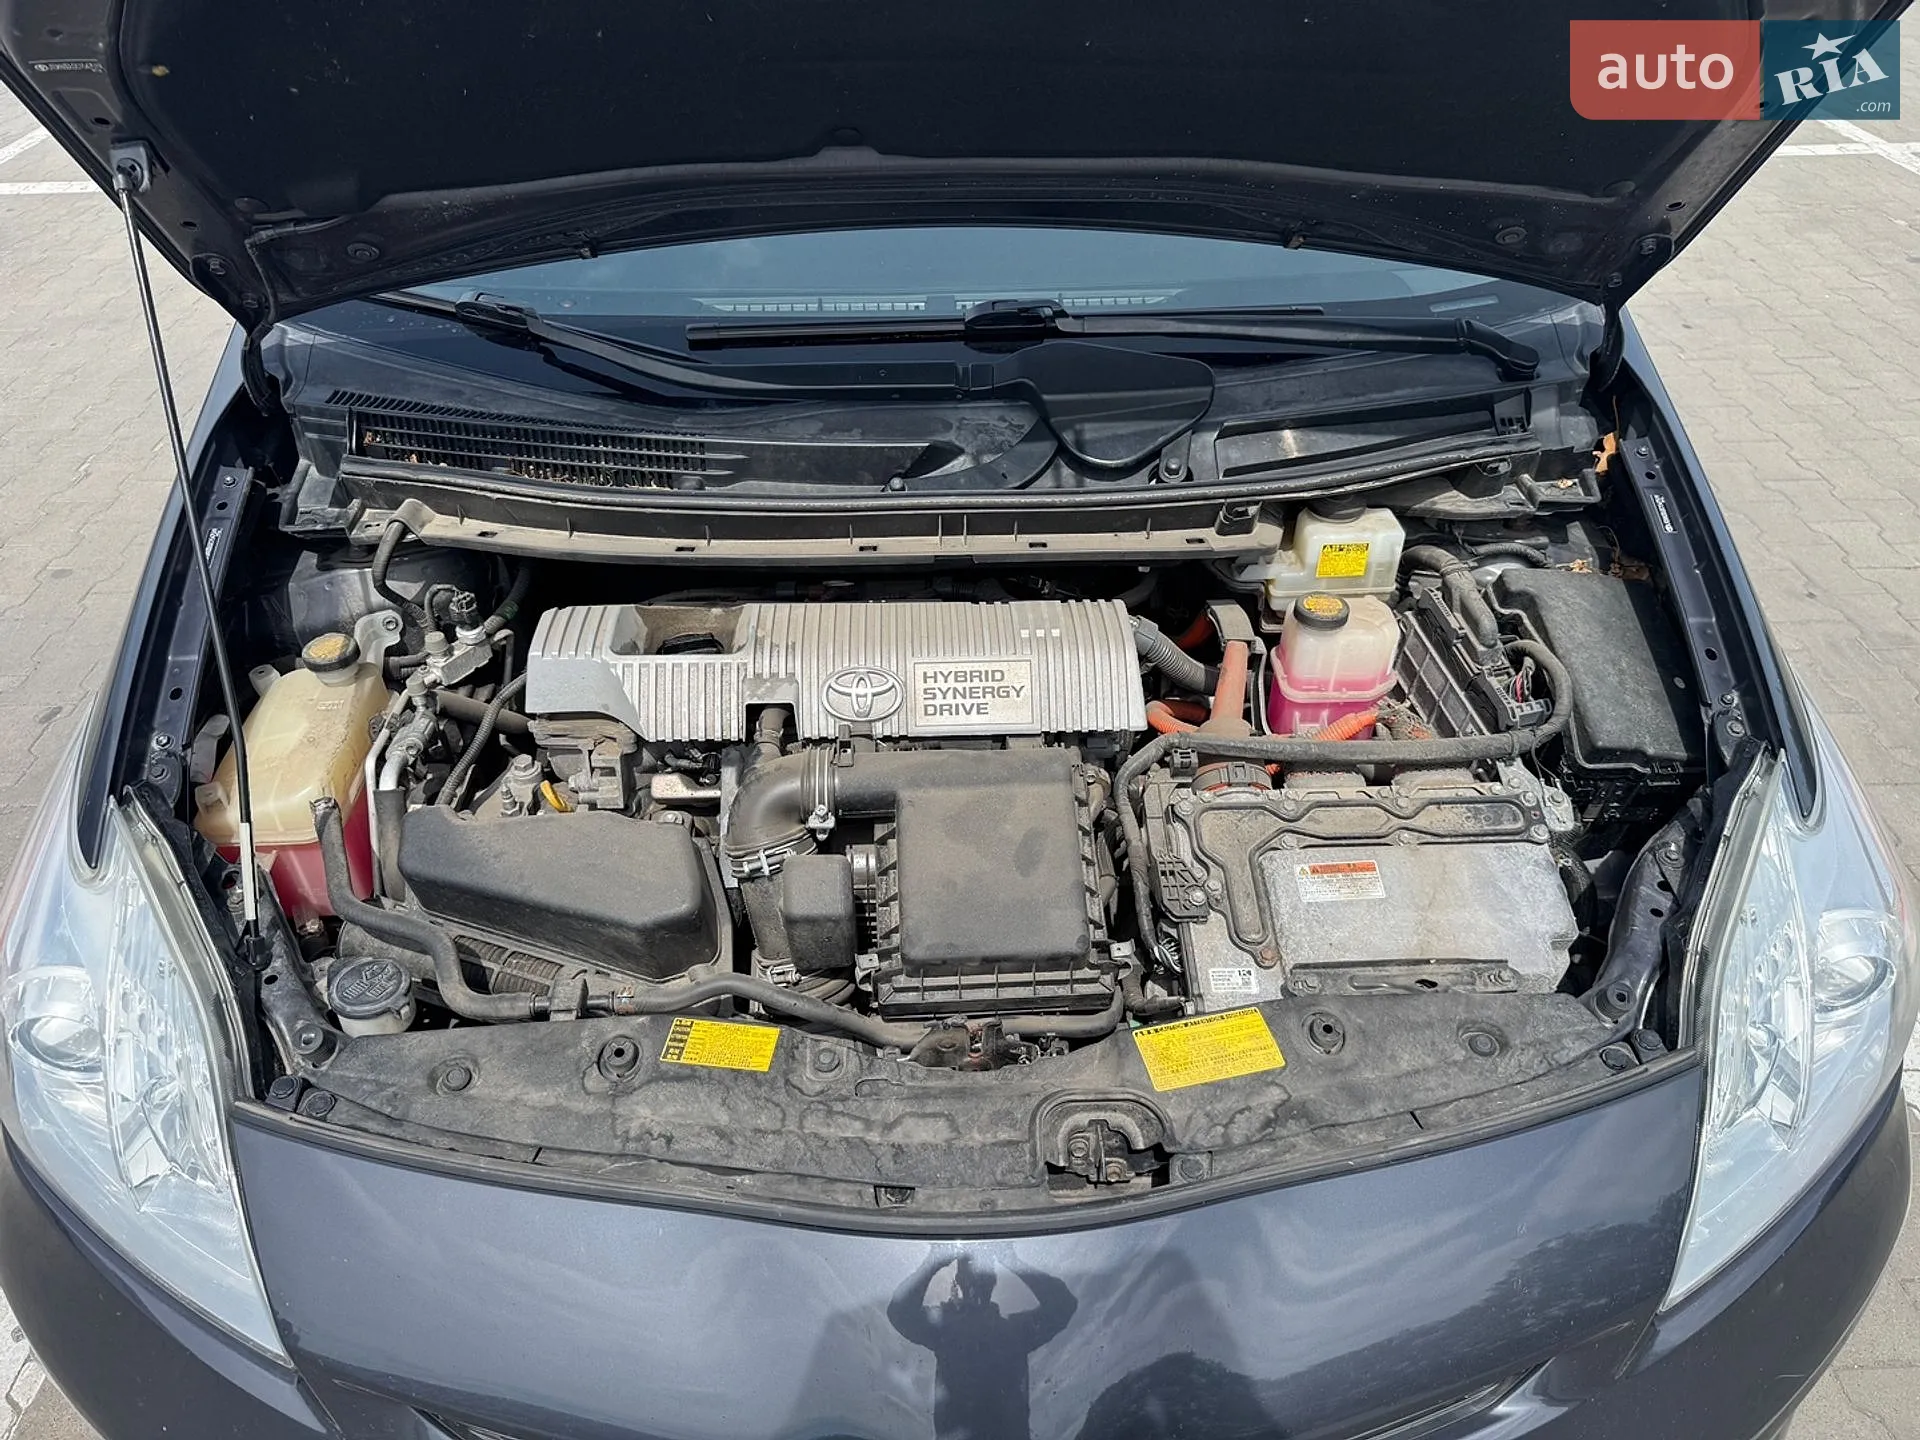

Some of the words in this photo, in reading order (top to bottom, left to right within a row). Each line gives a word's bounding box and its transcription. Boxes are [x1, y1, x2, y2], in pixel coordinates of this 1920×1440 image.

[923, 669, 1005, 684] HYBRID
[923, 685, 1025, 700] SYNERGY
[923, 702, 989, 717] DRIVE
